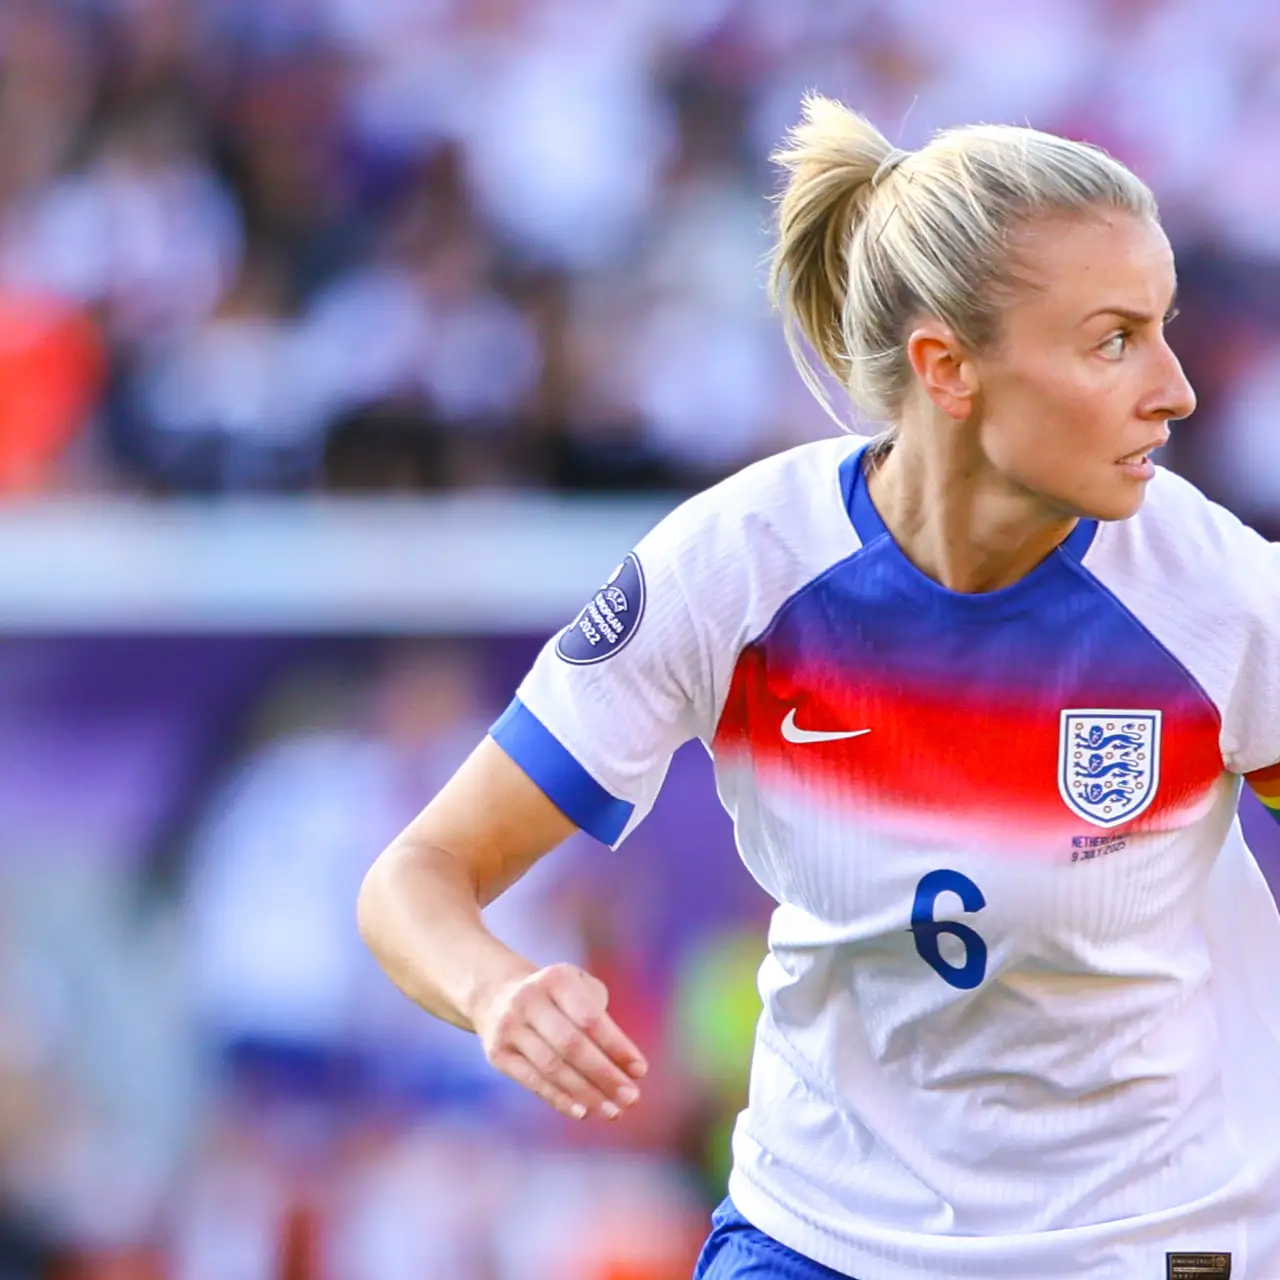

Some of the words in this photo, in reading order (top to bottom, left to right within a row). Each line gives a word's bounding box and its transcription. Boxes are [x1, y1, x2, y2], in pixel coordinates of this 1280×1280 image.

[579, 616, 601, 646] 2022
[1072, 851, 1079, 862] 9
[909, 868, 988, 990] 6
